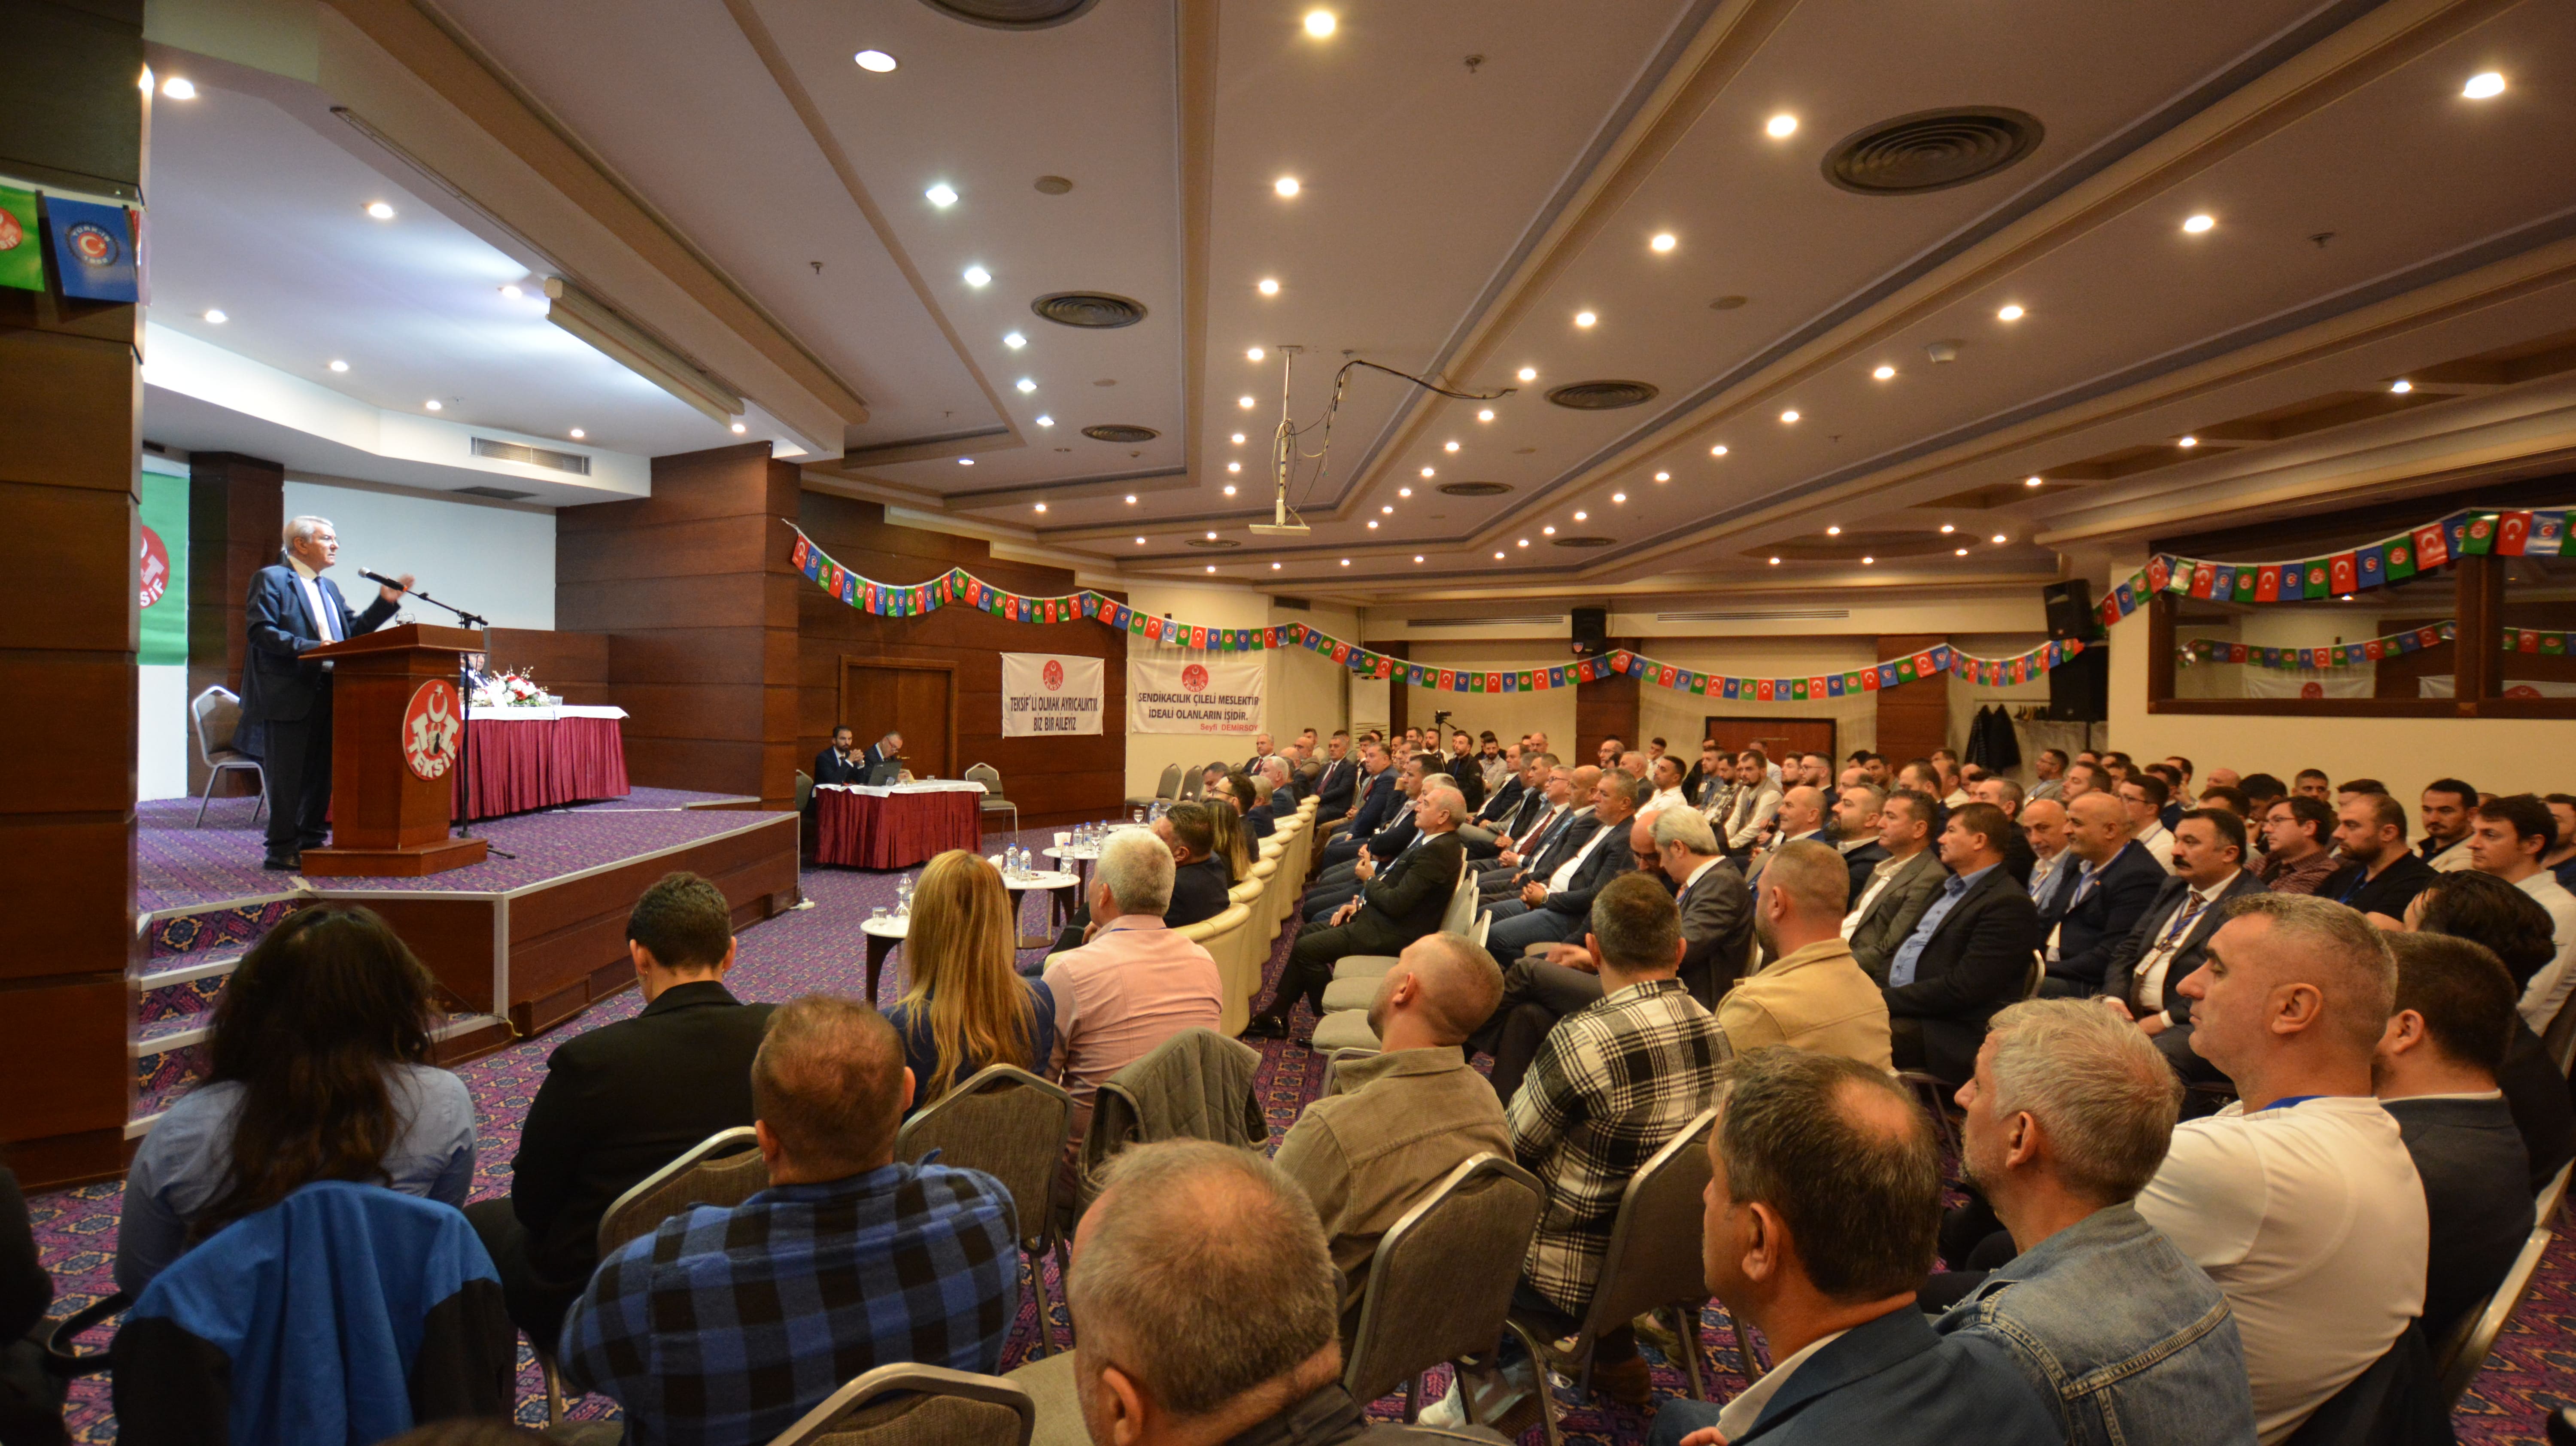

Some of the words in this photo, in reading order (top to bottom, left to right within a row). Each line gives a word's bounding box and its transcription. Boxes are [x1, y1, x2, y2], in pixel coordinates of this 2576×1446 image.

[140, 578, 164, 606] SİF
[1039, 696, 1060, 711] OLMAK
[1061, 697, 1097, 711] AYRICALIKTIR
[1138, 690, 1191, 703] SENDİKACILIK
[1193, 692, 1216, 706] ÇİLELİ
[1218, 694, 1259, 705] MESLEKTİR
[1034, 713, 1043, 731] BİZ
[1045, 713, 1054, 731] BİR
[1055, 713, 1076, 731] AİLEYİZ
[1149, 706, 1174, 718] İDEALİ
[1176, 709, 1222, 720] OLANLARIN
[1224, 708, 1248, 723] İŞİDİR.
[1200, 723, 1218, 732] Seyfi
[1221, 723, 1258, 731] DEMİRSOY
